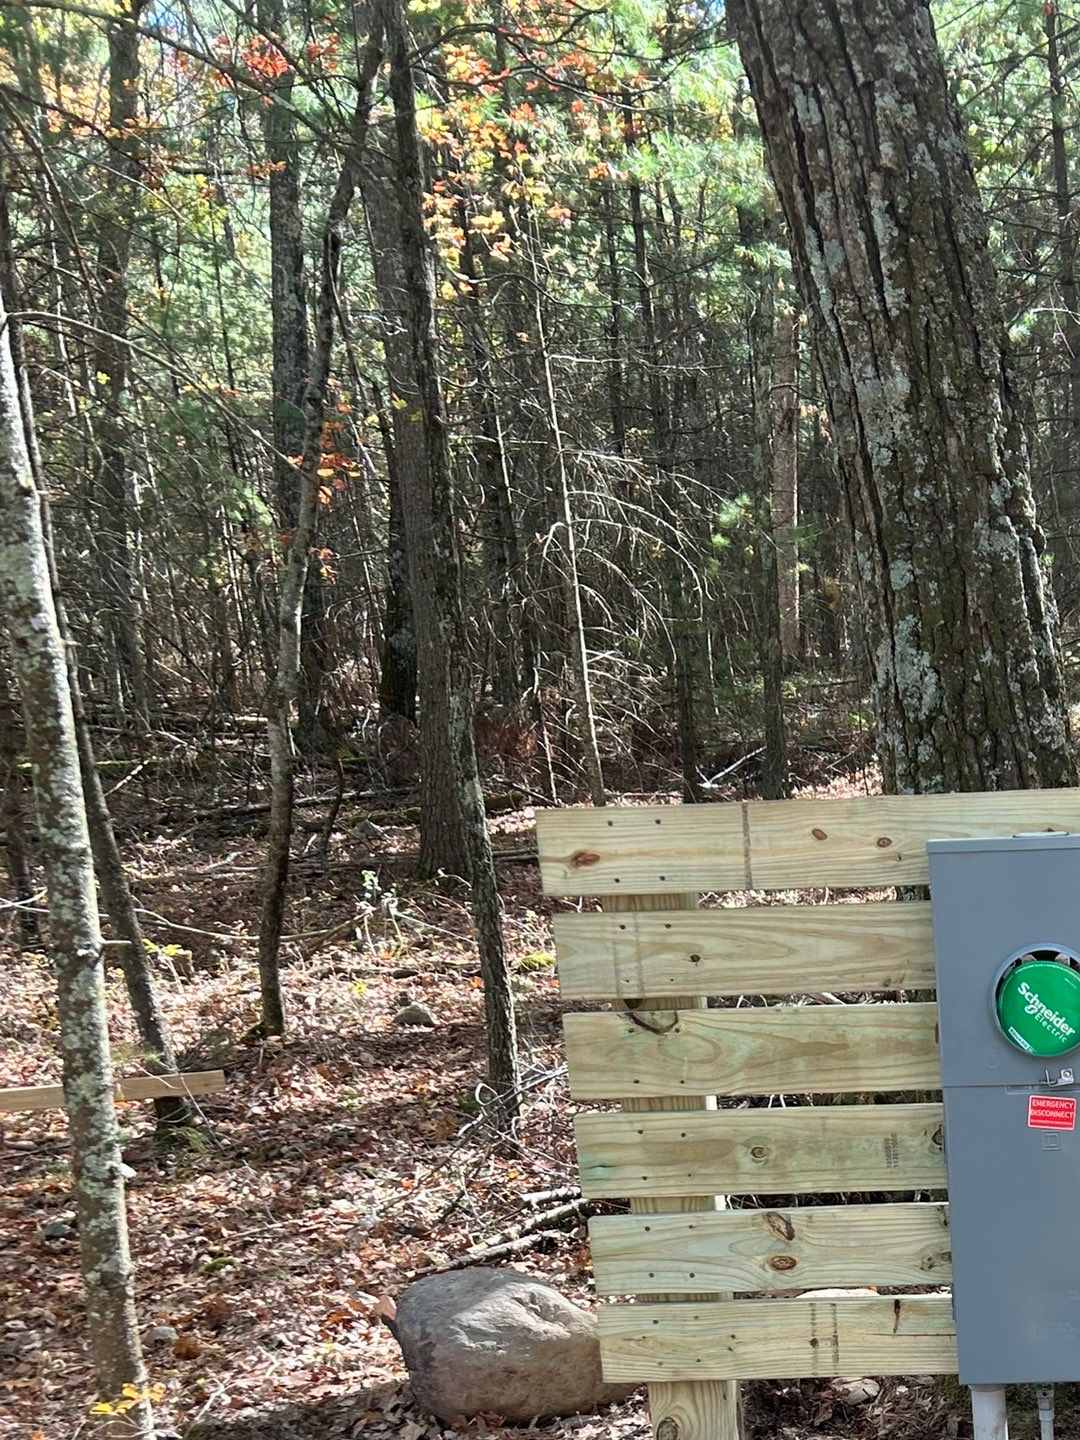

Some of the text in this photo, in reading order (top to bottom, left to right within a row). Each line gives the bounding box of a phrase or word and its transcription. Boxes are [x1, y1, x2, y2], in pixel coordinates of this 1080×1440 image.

[1017, 981, 1076, 1036] Schneider
[1034, 1012, 1068, 1043] Electric
[1030, 1109, 1074, 1119] DISCONNECT
[1032, 1099, 1074, 1109] EMERGENCY
